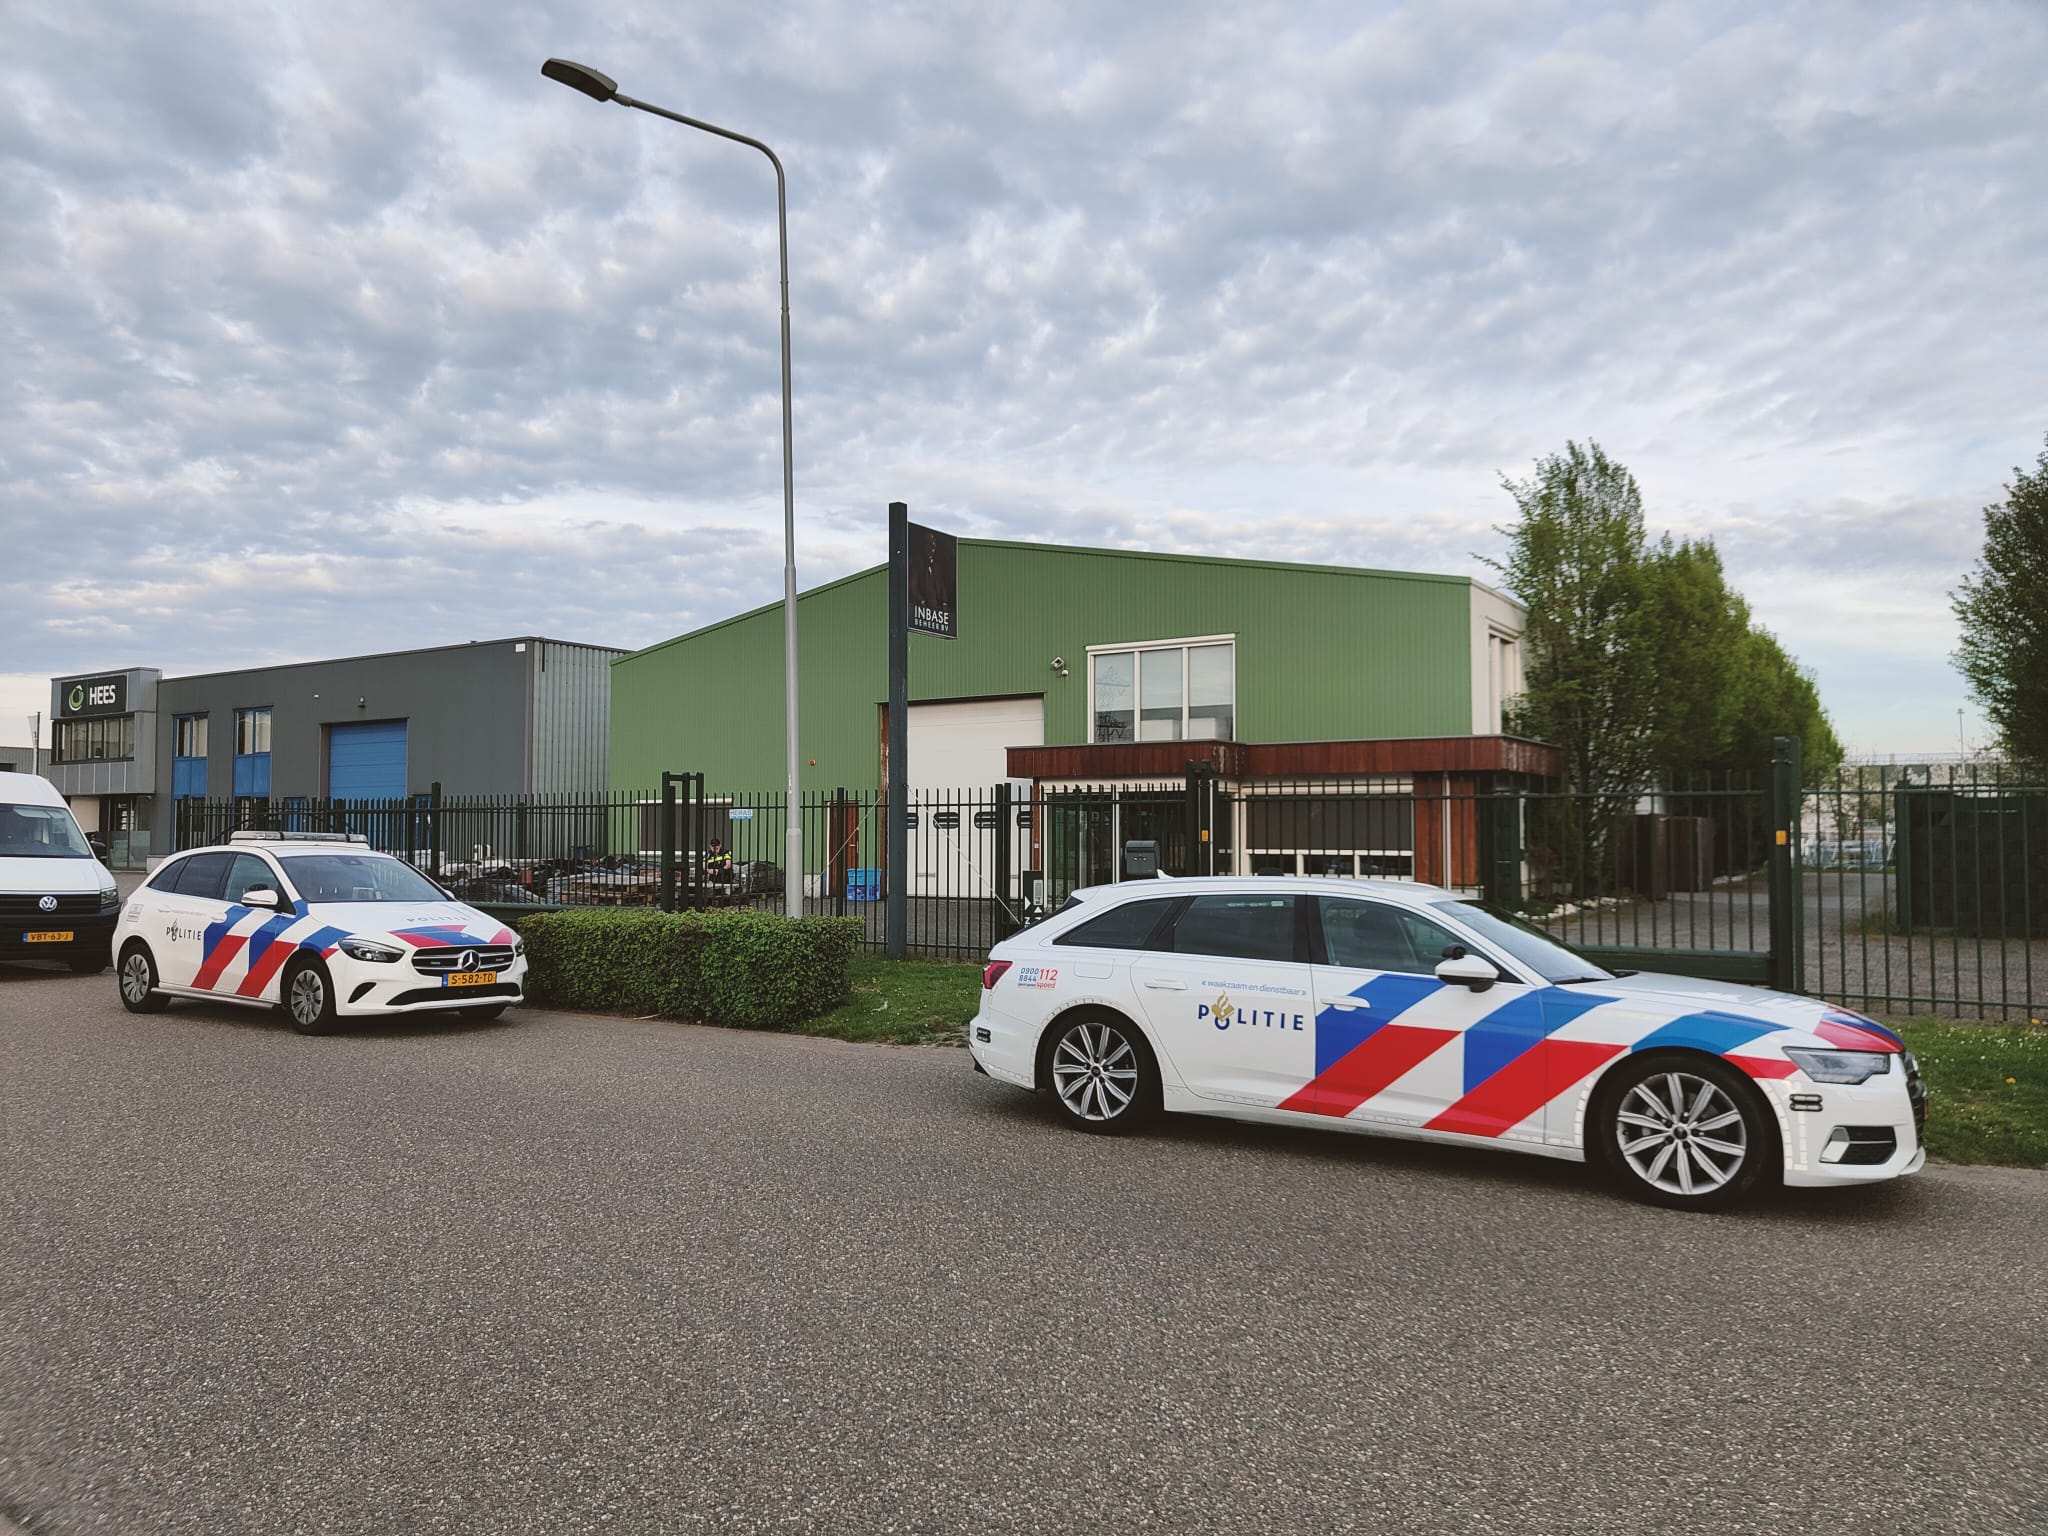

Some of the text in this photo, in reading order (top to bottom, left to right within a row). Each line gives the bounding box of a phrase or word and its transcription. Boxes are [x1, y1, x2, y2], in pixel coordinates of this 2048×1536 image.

[914, 605, 949, 625] INBASE
[89, 685, 116, 706] HEES
[166, 925, 202, 942] POLITIE
[451, 973, 493, 985] S-582-TD
[1040, 968, 1058, 981] 112
[1198, 1003, 1304, 1031] POLITIE
